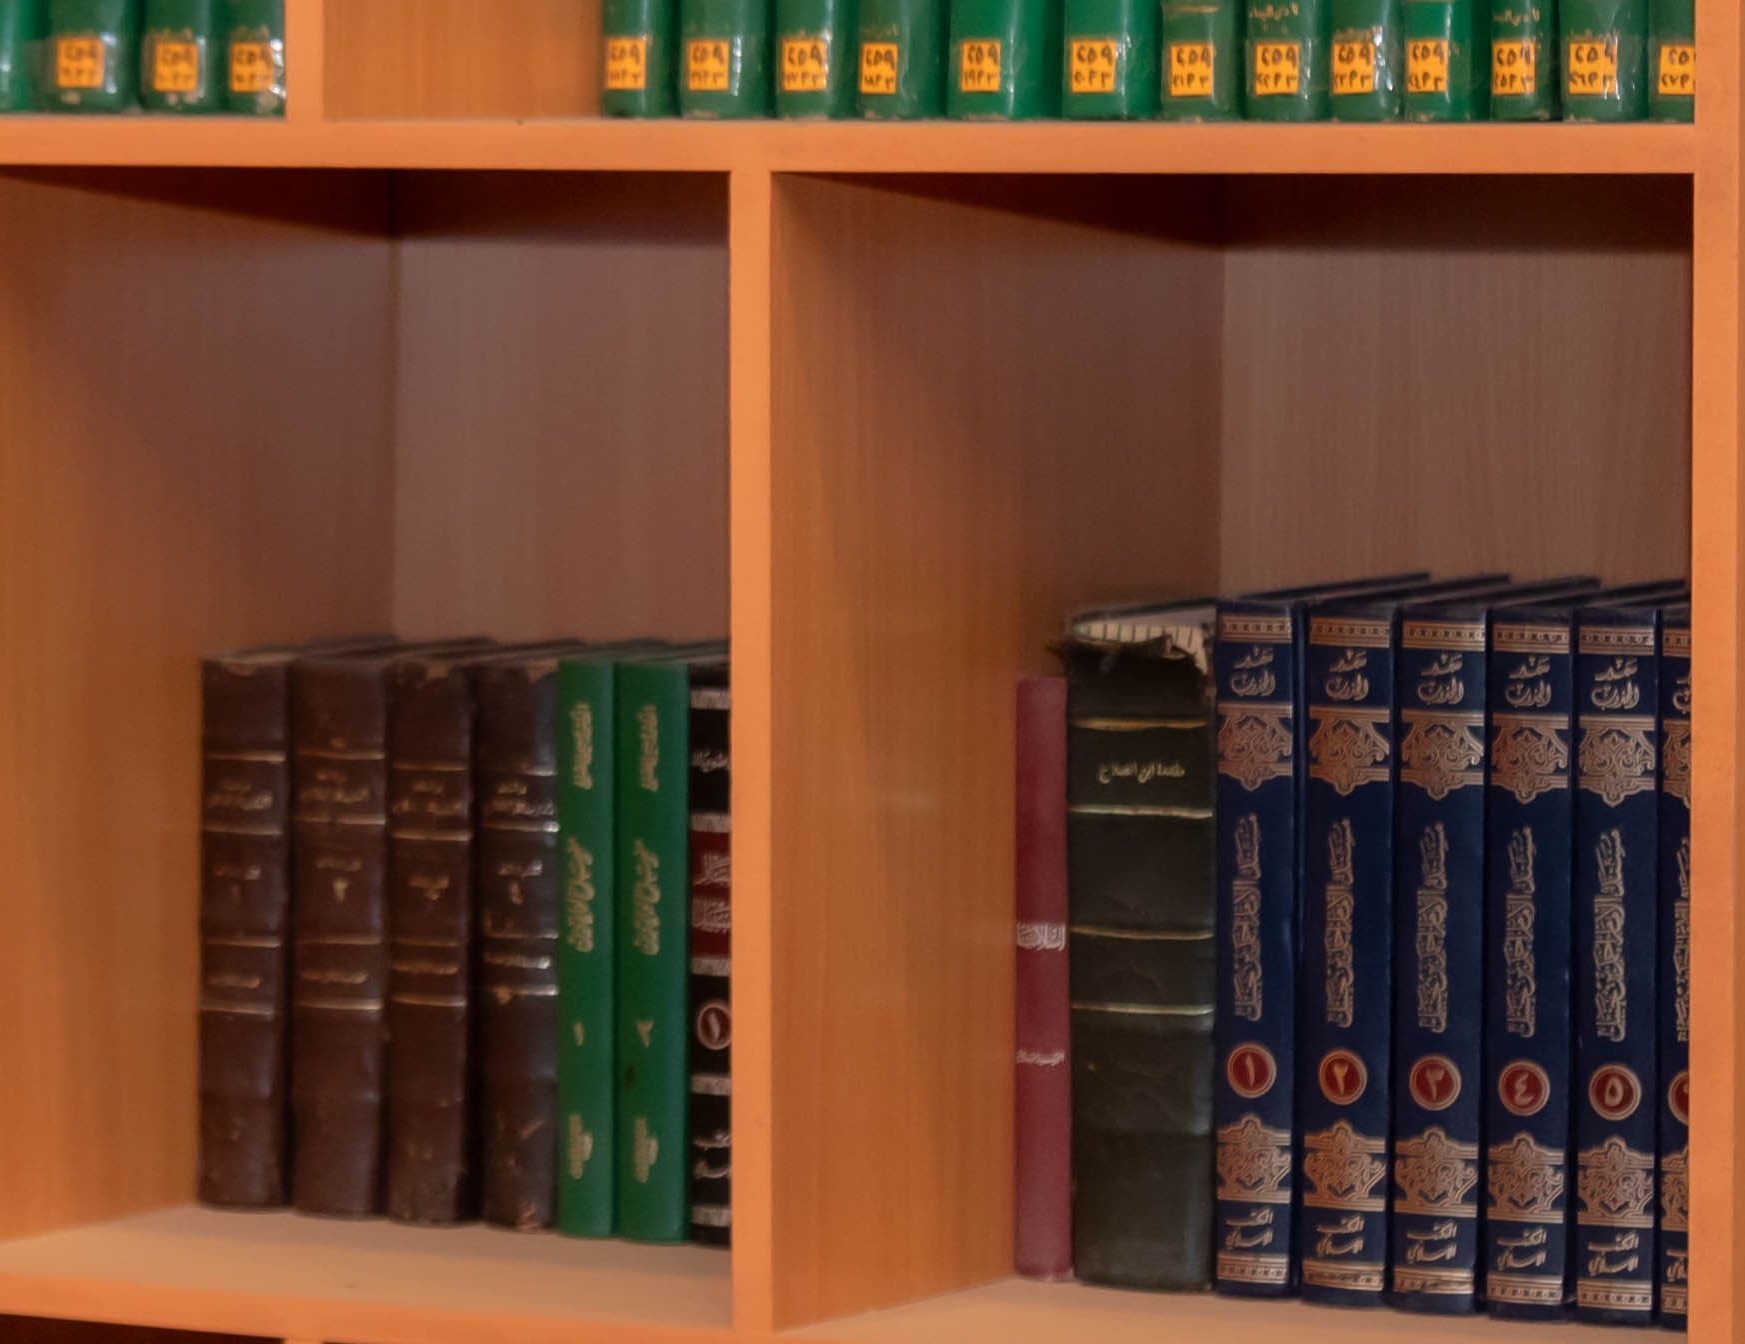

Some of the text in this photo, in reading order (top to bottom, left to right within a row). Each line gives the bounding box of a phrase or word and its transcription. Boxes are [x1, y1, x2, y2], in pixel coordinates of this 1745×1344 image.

[1245, 1058, 1257, 1085] ١
[1330, 1059, 1350, 1090] ٢
[1423, 1066, 1445, 1099] ٣
[1512, 1075, 1536, 1105] ٤
[1605, 1079, 1625, 1103] ٥
